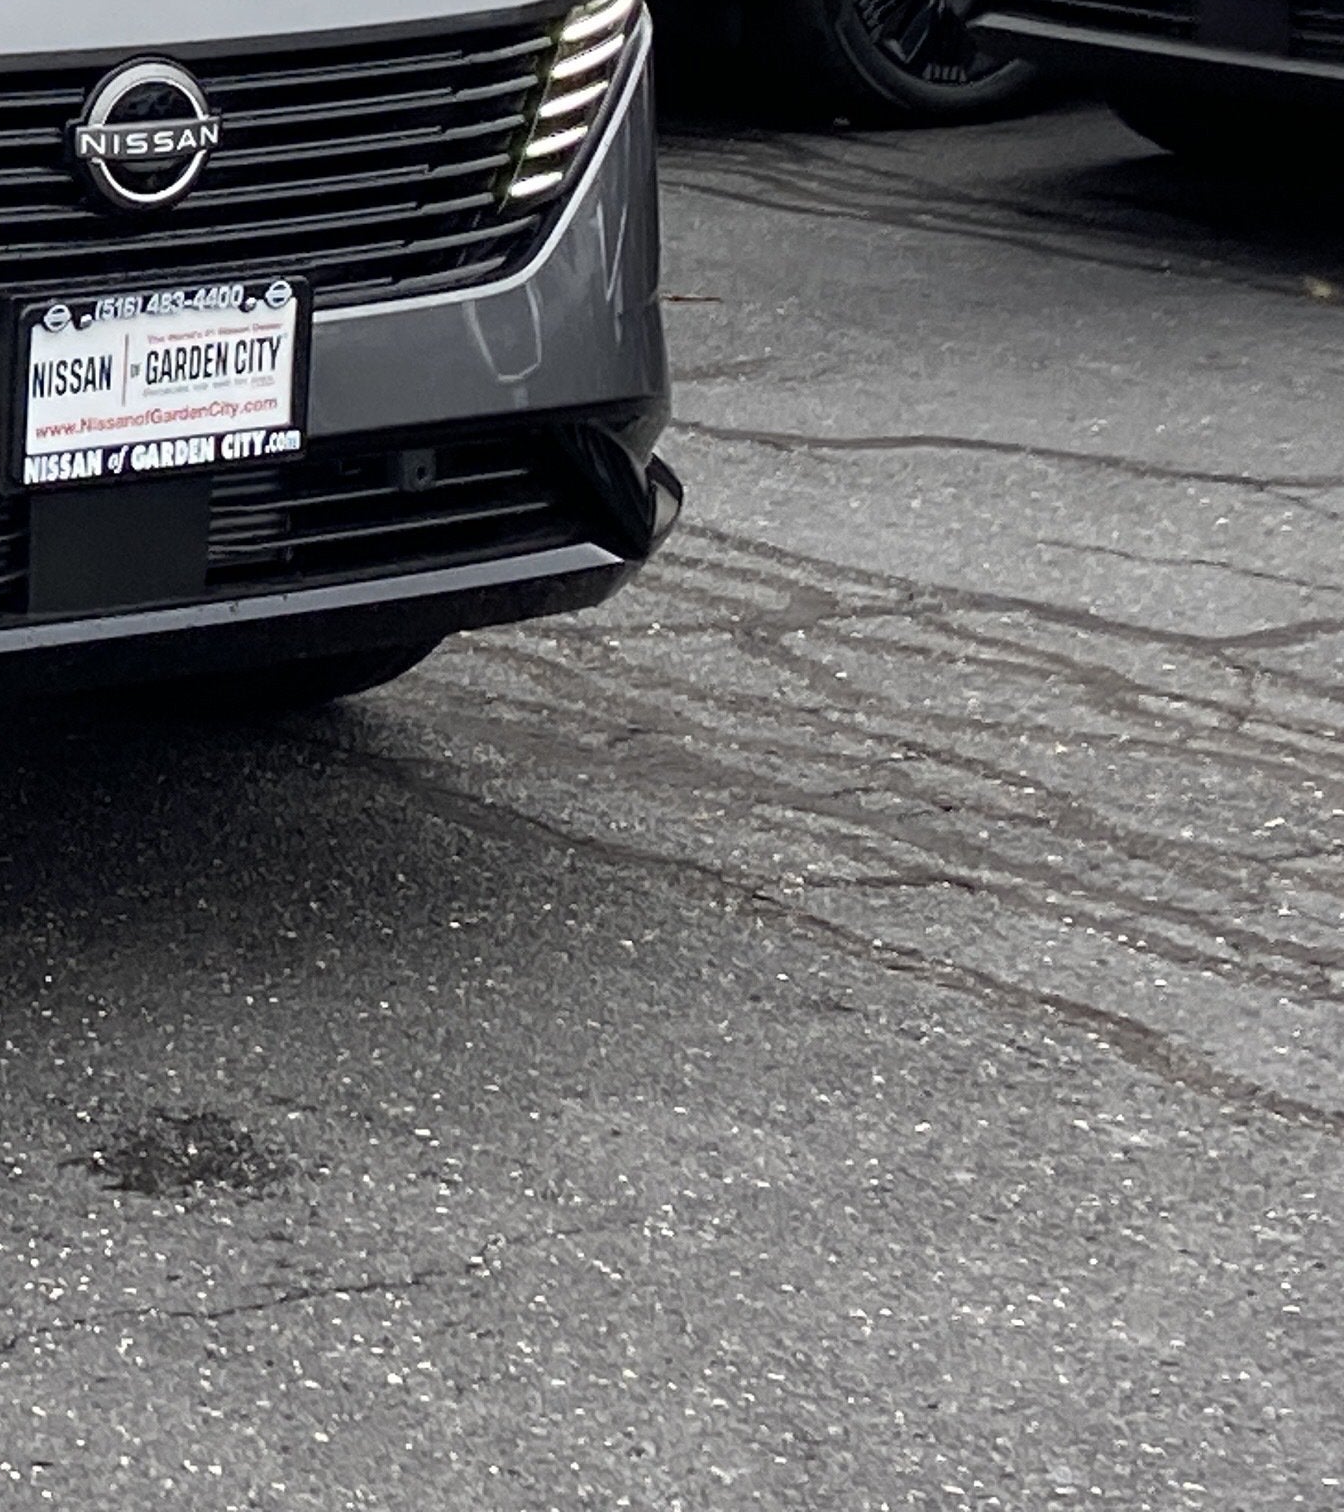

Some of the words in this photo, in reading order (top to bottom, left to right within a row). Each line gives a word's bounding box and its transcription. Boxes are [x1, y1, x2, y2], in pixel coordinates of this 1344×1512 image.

[80, 123, 219, 155] NISSAN
[32, 354, 114, 399] NISSAN
[145, 341, 229, 386] GARDEN
[234, 335, 282, 375] CITY
[35, 396, 279, 439] www.NissanofGardenCity.com
[23, 449, 103, 485] NISSAN
[108, 444, 130, 474] of
[130, 436, 215, 471] GARDEN
